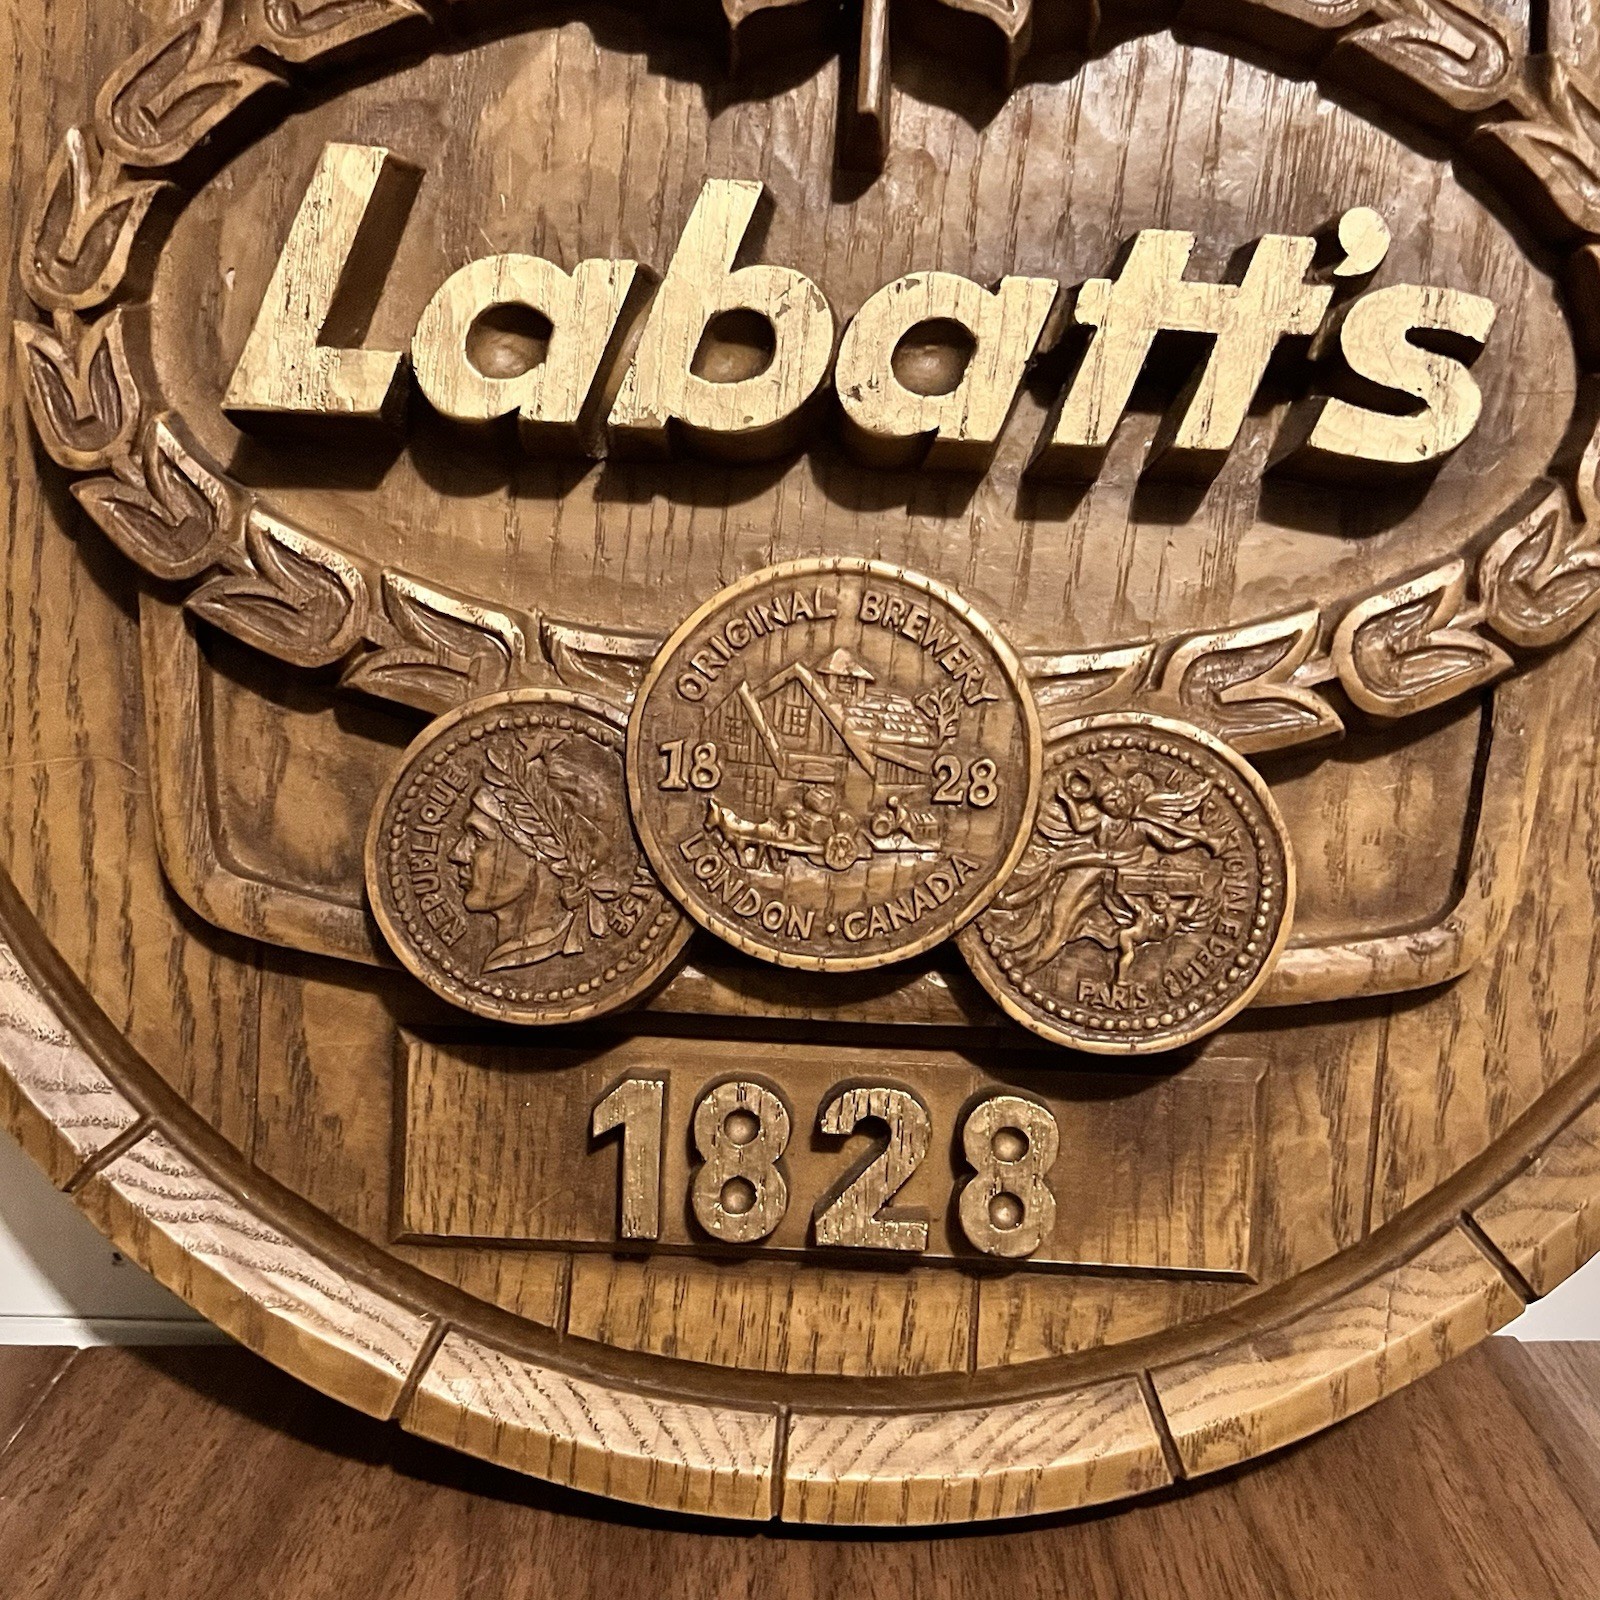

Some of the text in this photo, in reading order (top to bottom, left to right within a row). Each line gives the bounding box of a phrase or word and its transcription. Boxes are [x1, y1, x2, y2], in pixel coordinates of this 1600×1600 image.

[223, 142, 1499, 464] Labatt's
[676, 587, 999, 706] ORIGINAL BREWERY
[657, 739, 999, 808] 18 28
[410, 764, 469, 947] REPUBLIQUE
[678, 831, 980, 941] LONDON CANADA
[1077, 978, 1151, 1011] PARIS
[592, 1078, 1060, 1258] 1828
